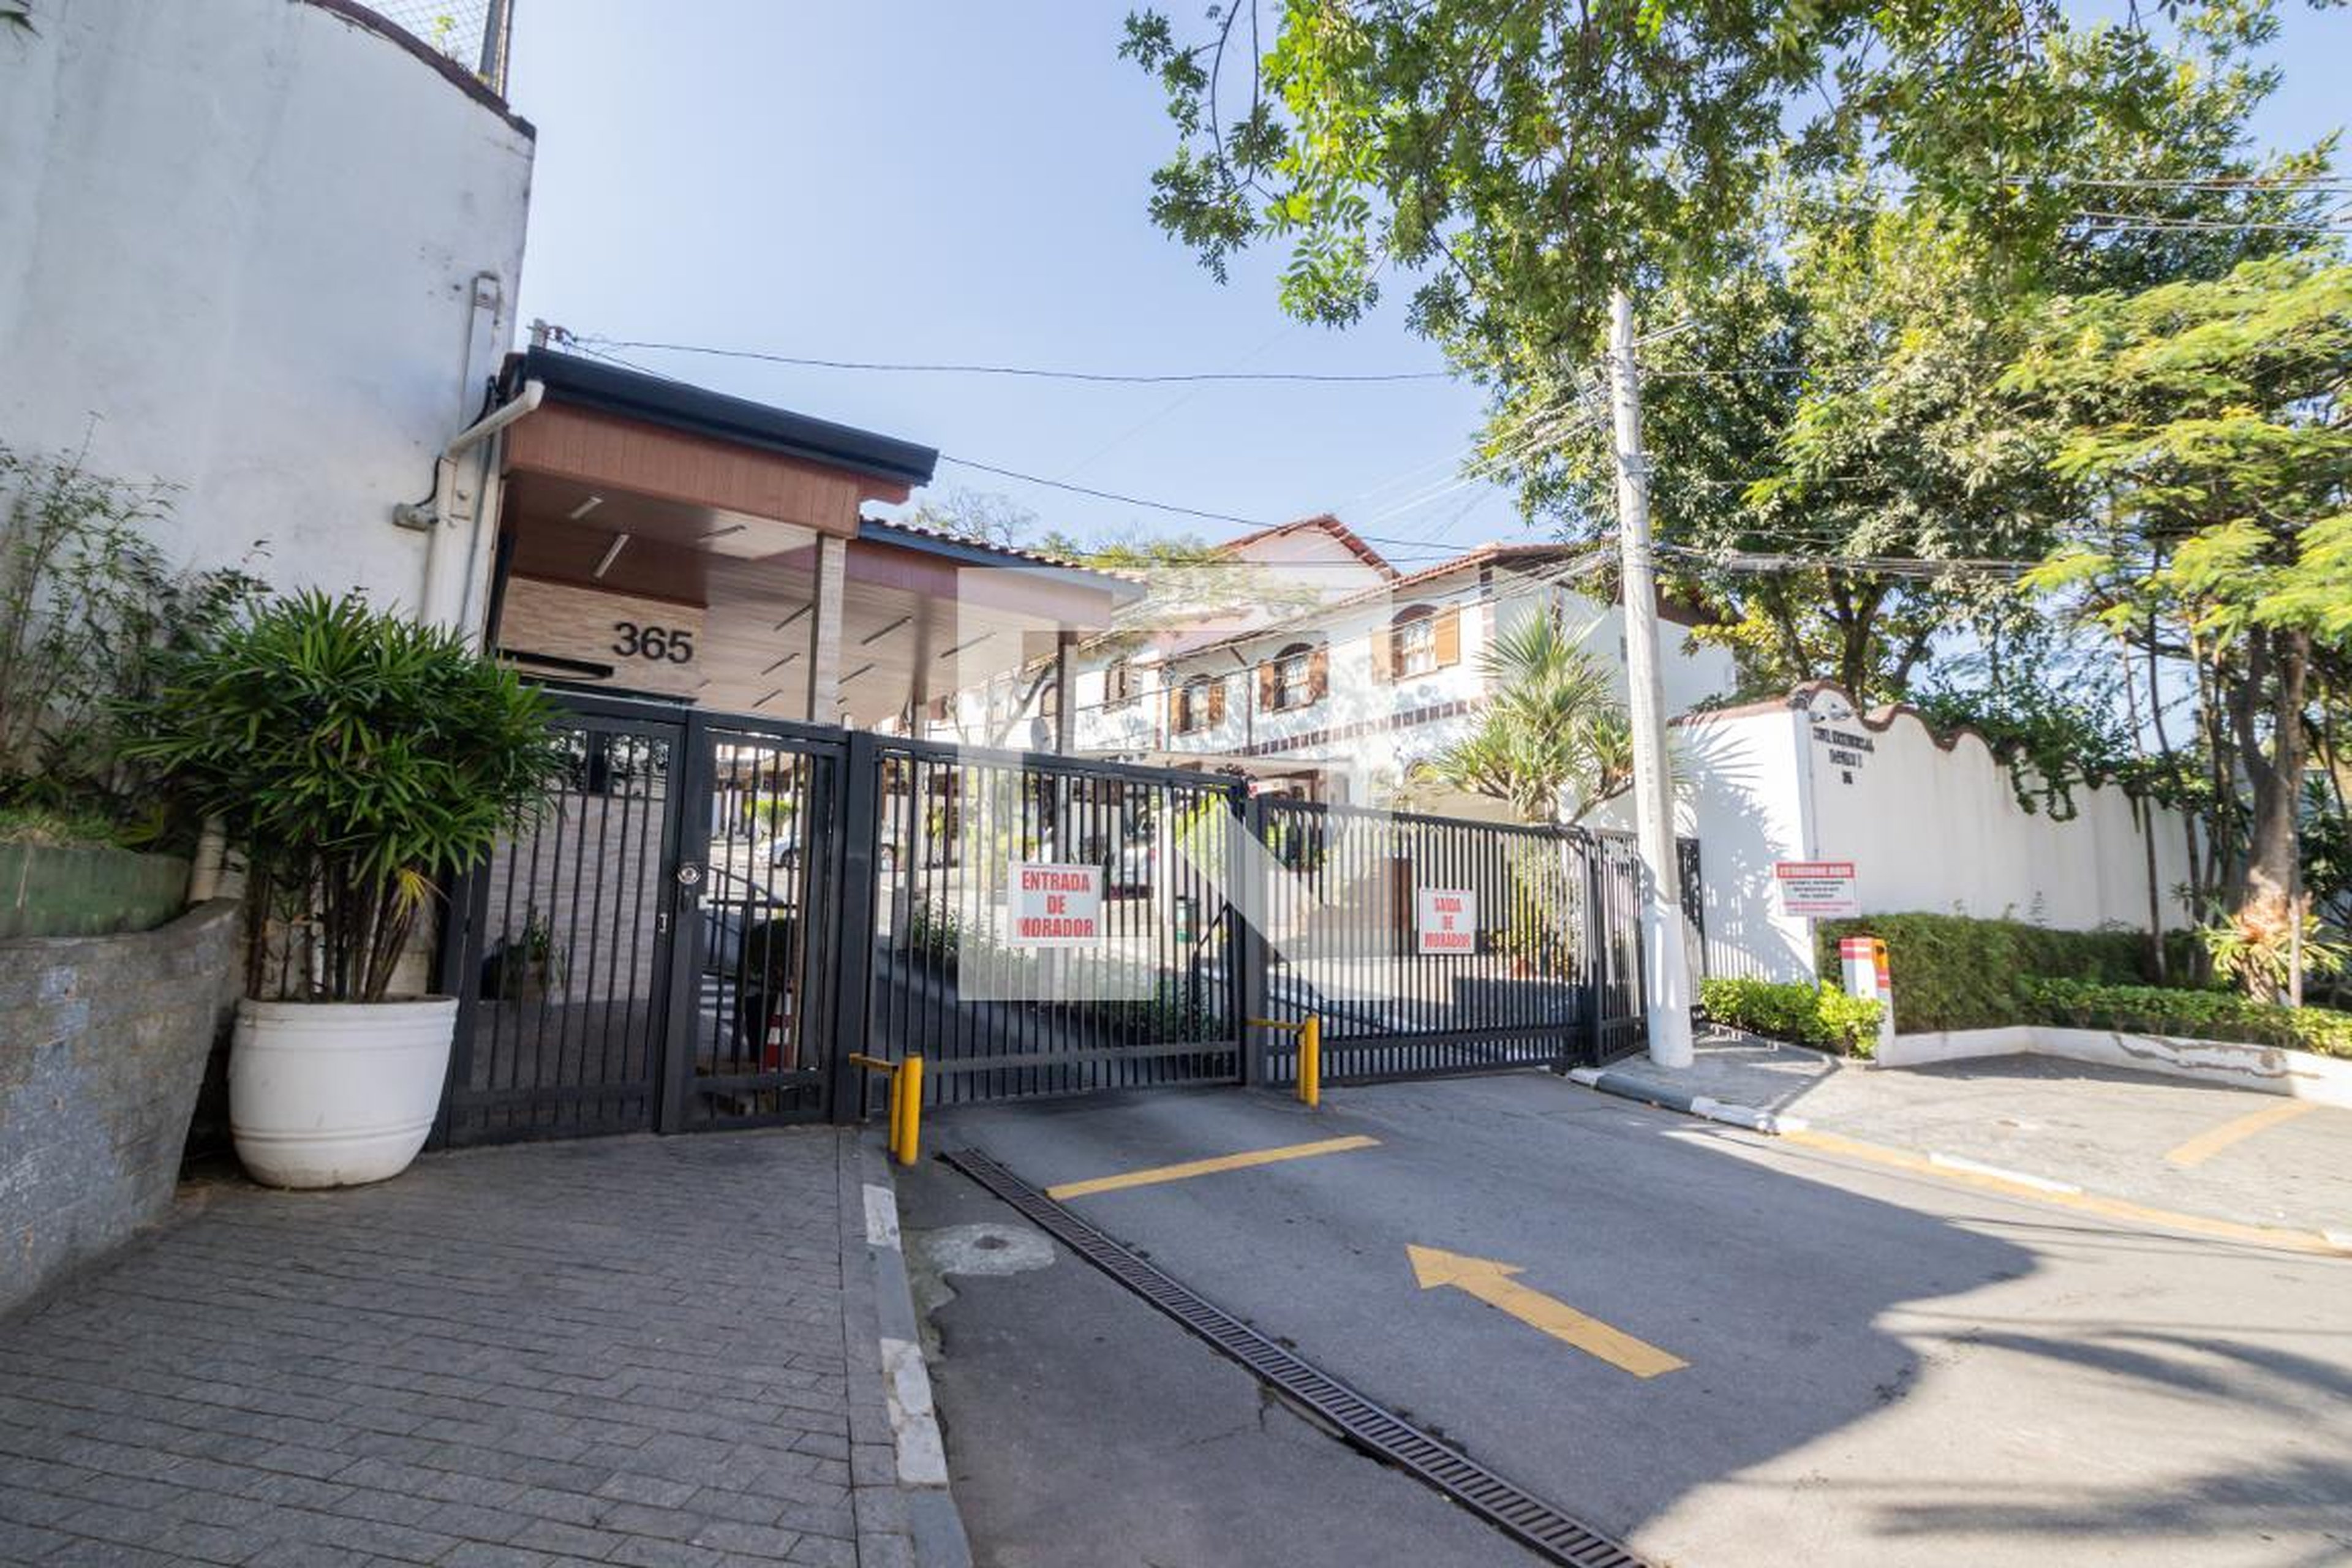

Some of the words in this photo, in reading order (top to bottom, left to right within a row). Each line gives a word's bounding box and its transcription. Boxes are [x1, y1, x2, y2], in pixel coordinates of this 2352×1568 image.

[612, 622, 693, 664] 365
[1022, 870, 1090, 893] ENTRADA
[1047, 895, 1066, 914] DE
[1017, 917, 1094, 937] MORADOR
